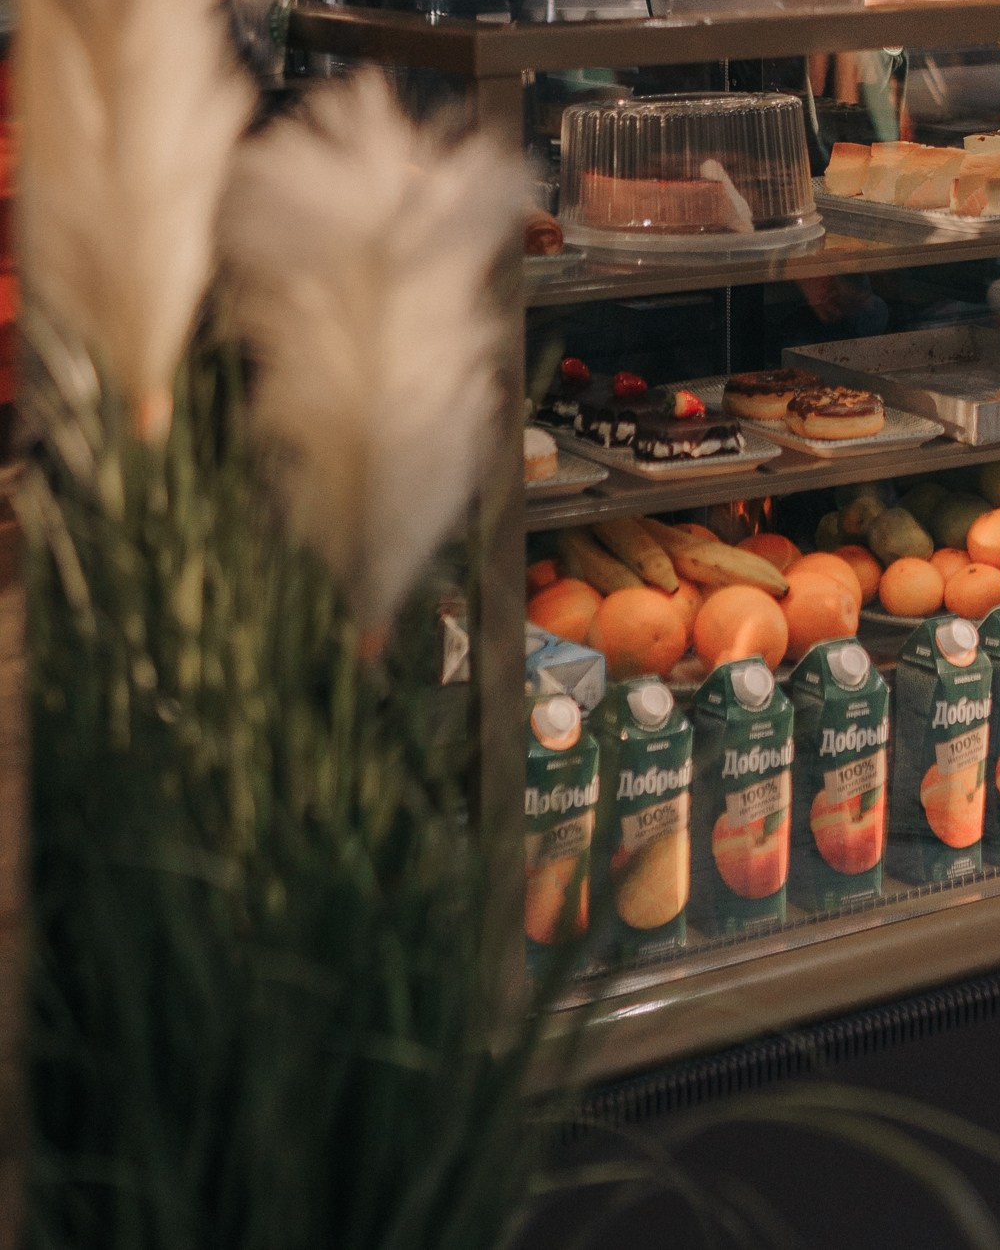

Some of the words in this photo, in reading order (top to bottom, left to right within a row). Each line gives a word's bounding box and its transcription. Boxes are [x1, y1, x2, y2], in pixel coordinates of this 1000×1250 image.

[820, 716, 889, 757] Добрый
[950, 732, 981, 755] 100%
[722, 735, 795, 780] Добрый
[838, 760, 874, 784] 100%
[617, 758, 693, 801] Добрый
[742, 781, 778, 807] 100%
